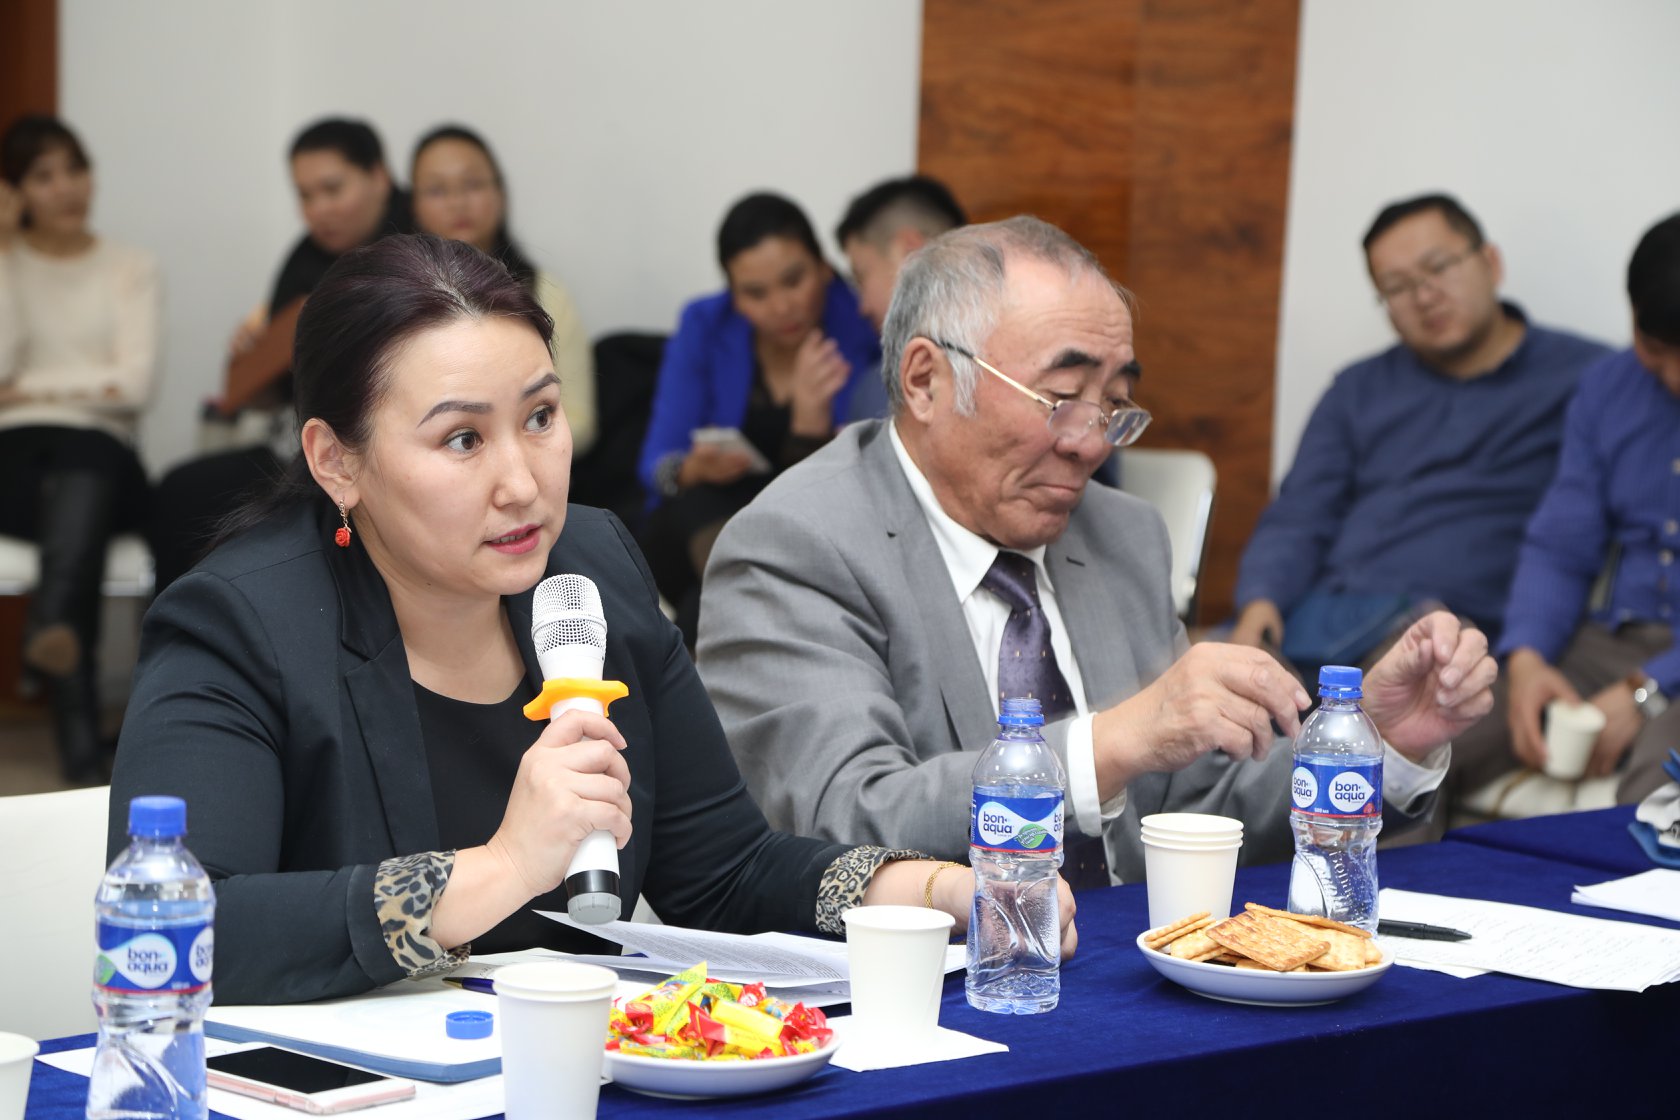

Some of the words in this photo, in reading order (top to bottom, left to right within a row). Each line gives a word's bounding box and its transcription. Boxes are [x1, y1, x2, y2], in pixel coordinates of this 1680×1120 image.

[1334, 791, 1365, 803] aqua
[983, 823, 1012, 835] aqua
[127, 962, 168, 976] aqua
